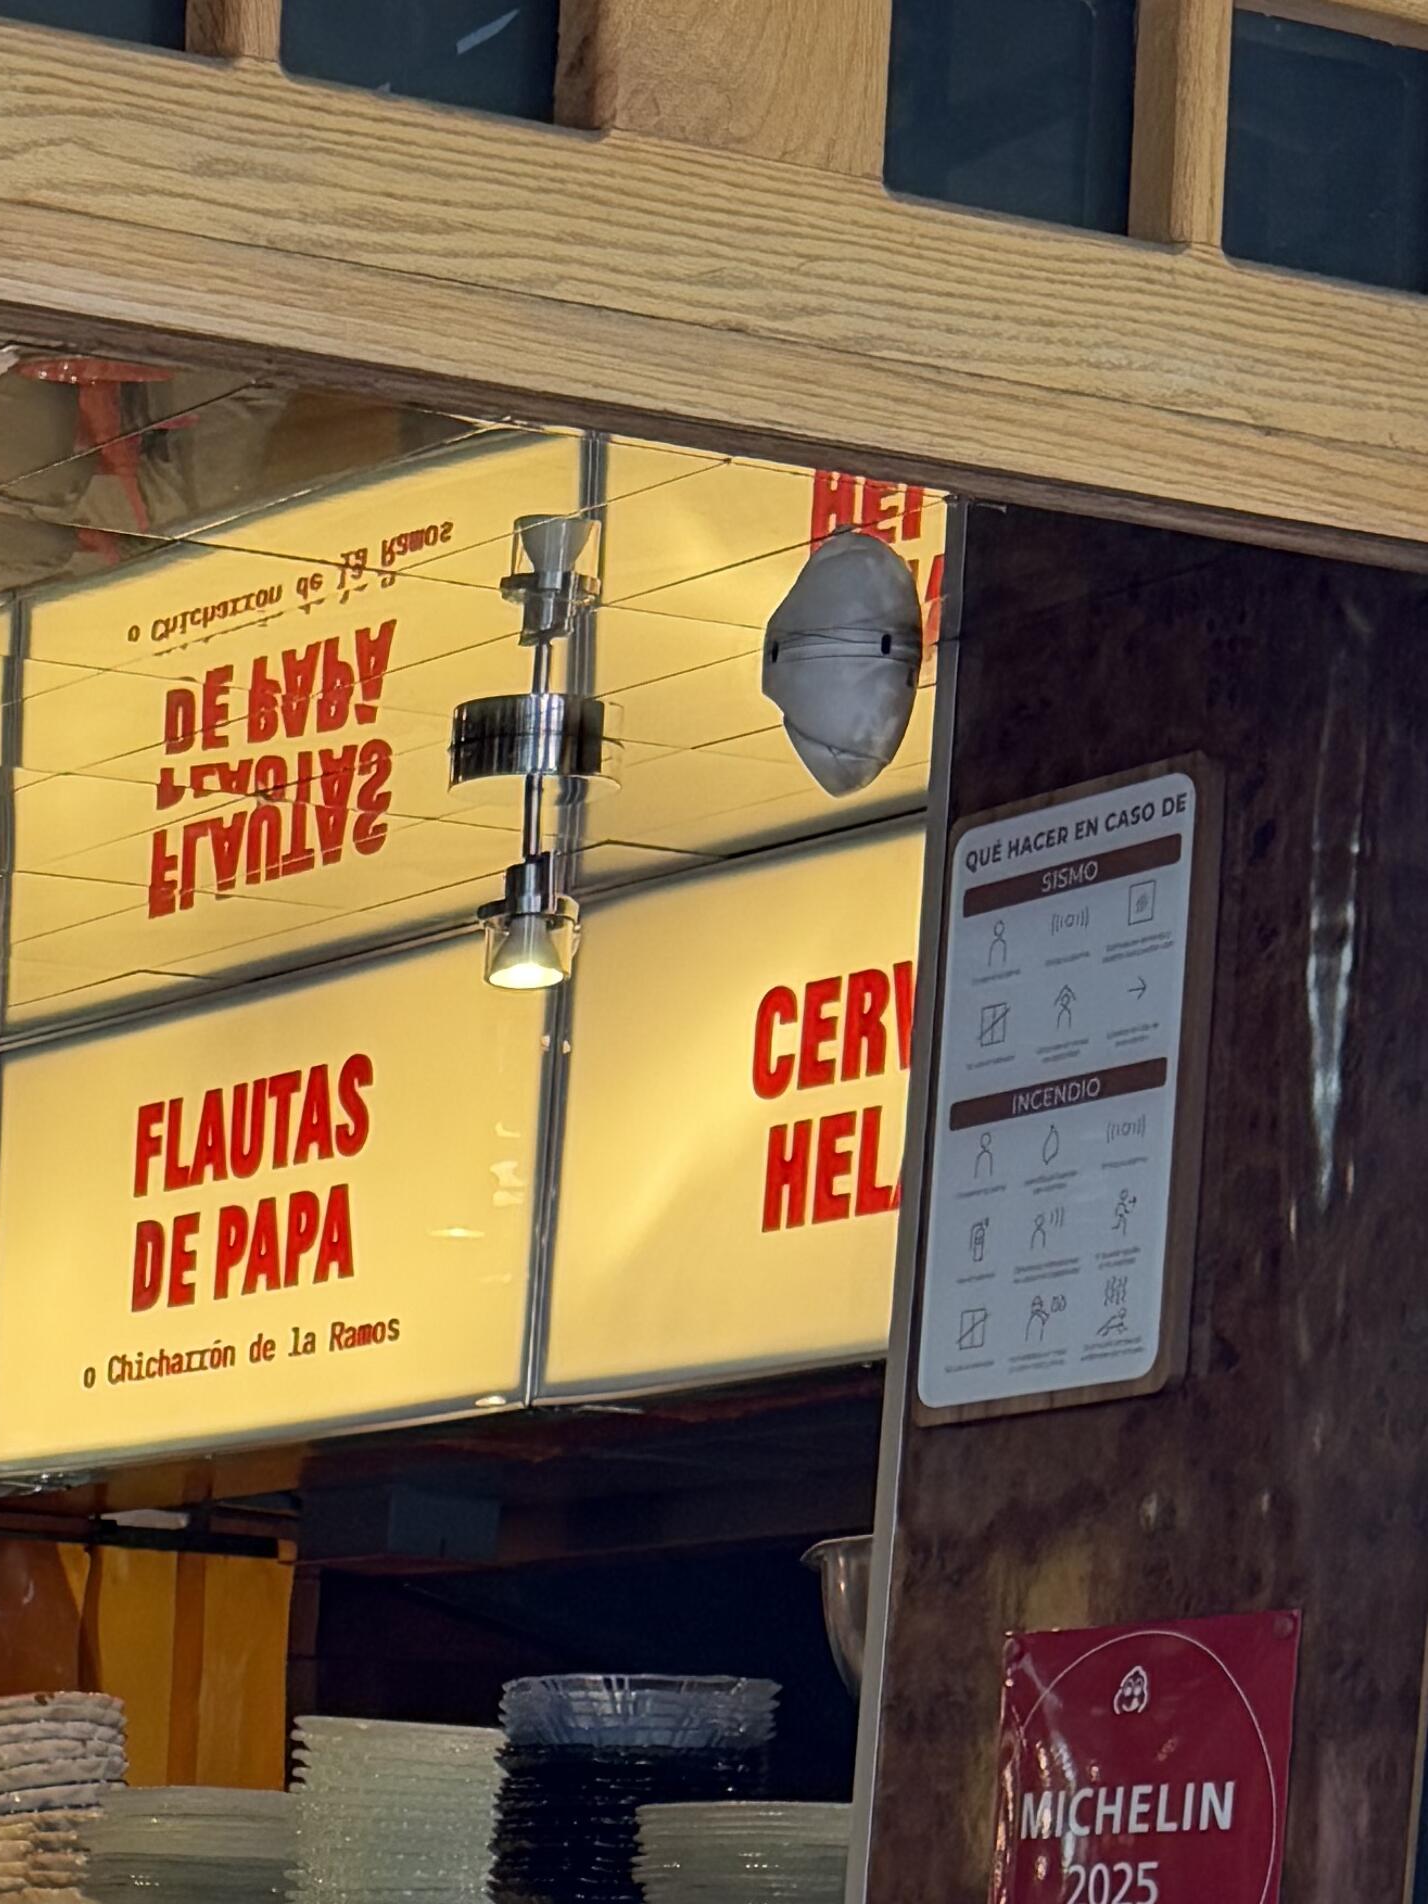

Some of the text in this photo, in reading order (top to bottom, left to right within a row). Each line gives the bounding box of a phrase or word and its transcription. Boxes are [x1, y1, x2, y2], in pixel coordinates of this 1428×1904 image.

[965, 791, 1188, 874] QUÉ HACER EN CASO DE
[1040, 860, 1100, 893] SISMO
[133, 1053, 374, 1198] FLAUTAS
[1011, 1076, 1102, 1115] INCENDIO
[131, 1182, 355, 1313] DE PAPA
[83, 1317, 401, 1389] o Chicharrón de la Ramos
[1019, 1780, 1235, 1840] MICHELIN
